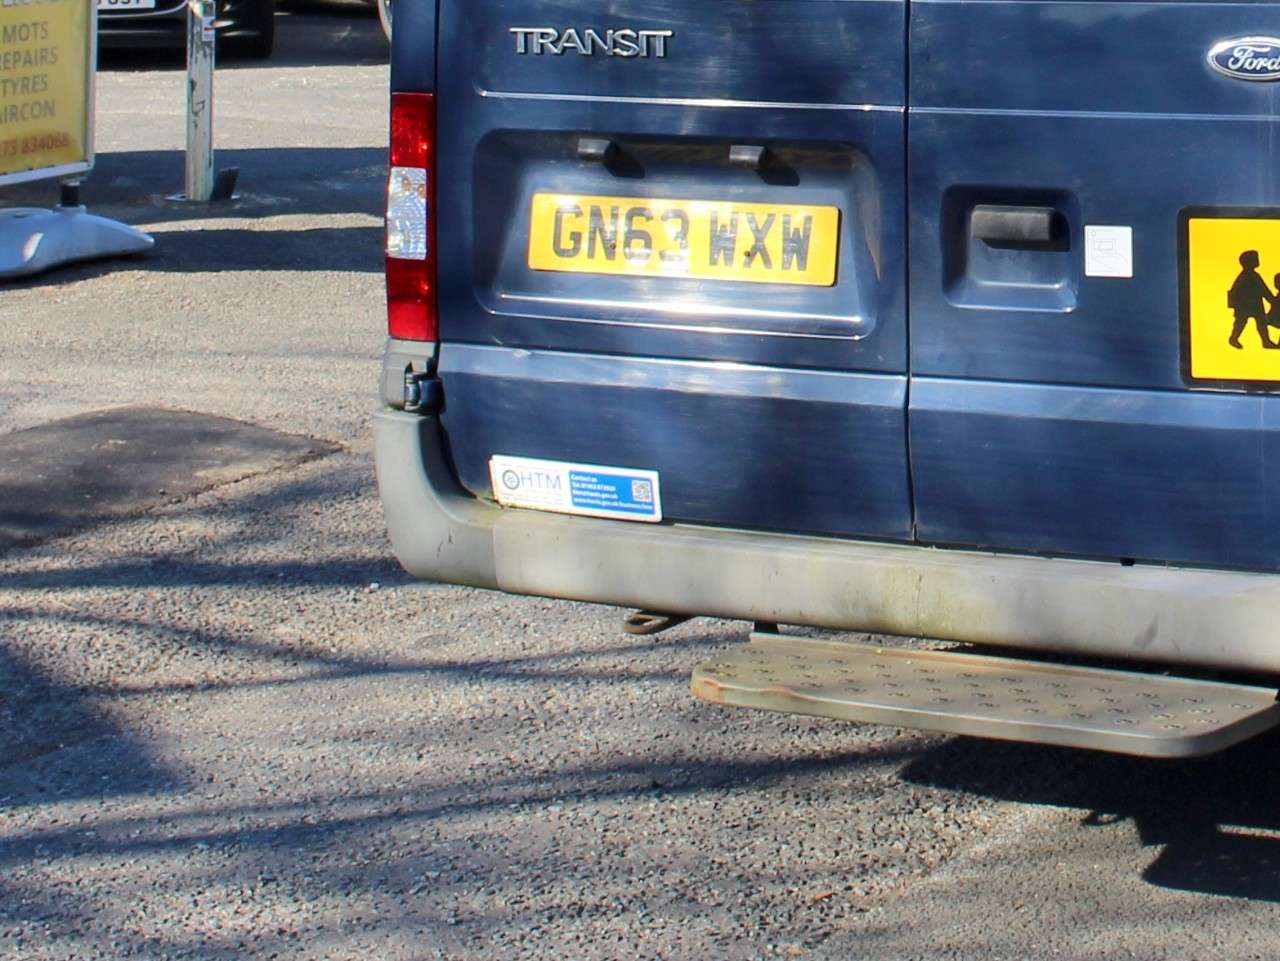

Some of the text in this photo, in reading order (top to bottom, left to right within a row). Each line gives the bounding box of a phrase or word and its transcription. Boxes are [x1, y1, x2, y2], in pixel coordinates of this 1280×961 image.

[2, 21, 49, 43] MOTS
[509, 27, 673, 58] TRANSIT
[1, 74, 49, 97] TYRES
[0, 139, 18, 159] 73
[552, 203, 813, 271] GN63 WXW
[520, 471, 563, 490] HTM
